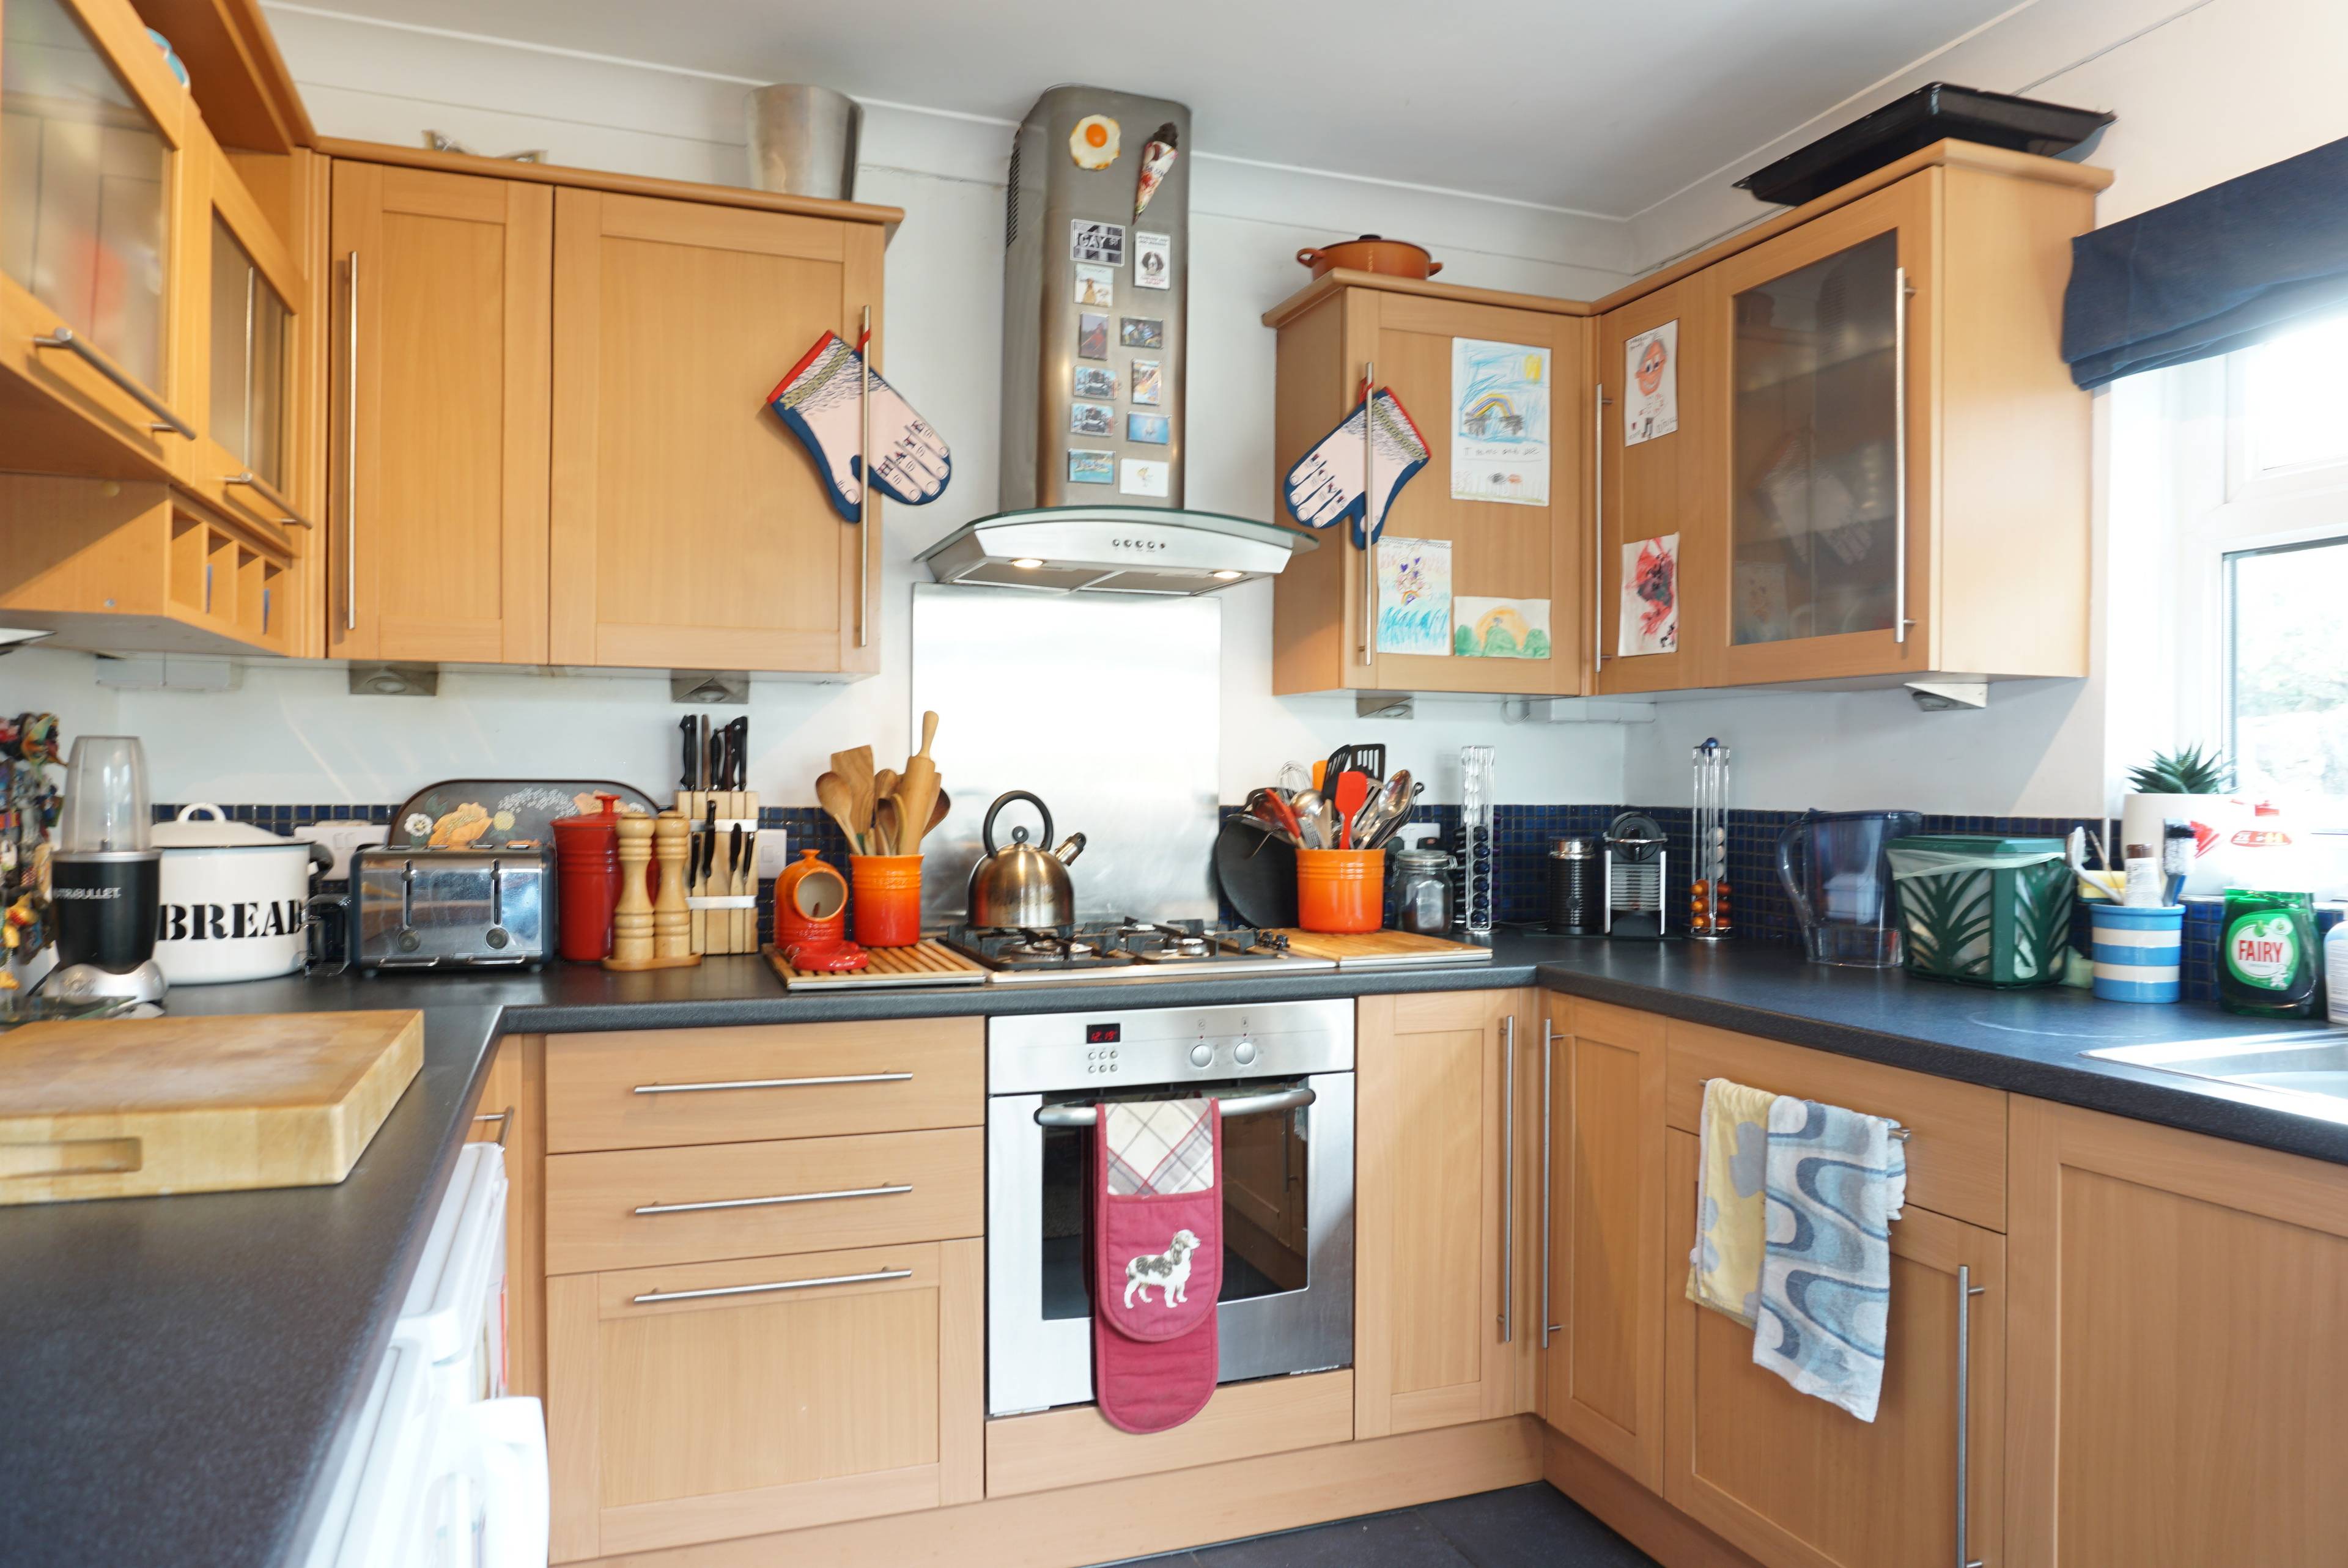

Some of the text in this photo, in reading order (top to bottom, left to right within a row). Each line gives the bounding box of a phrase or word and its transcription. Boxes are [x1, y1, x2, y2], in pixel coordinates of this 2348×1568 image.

[1078, 233, 1107, 249] GAY
[875, 420, 925, 479] HATE
[157, 899, 304, 940] BREAD
[2237, 939, 2284, 963] FAIRY
